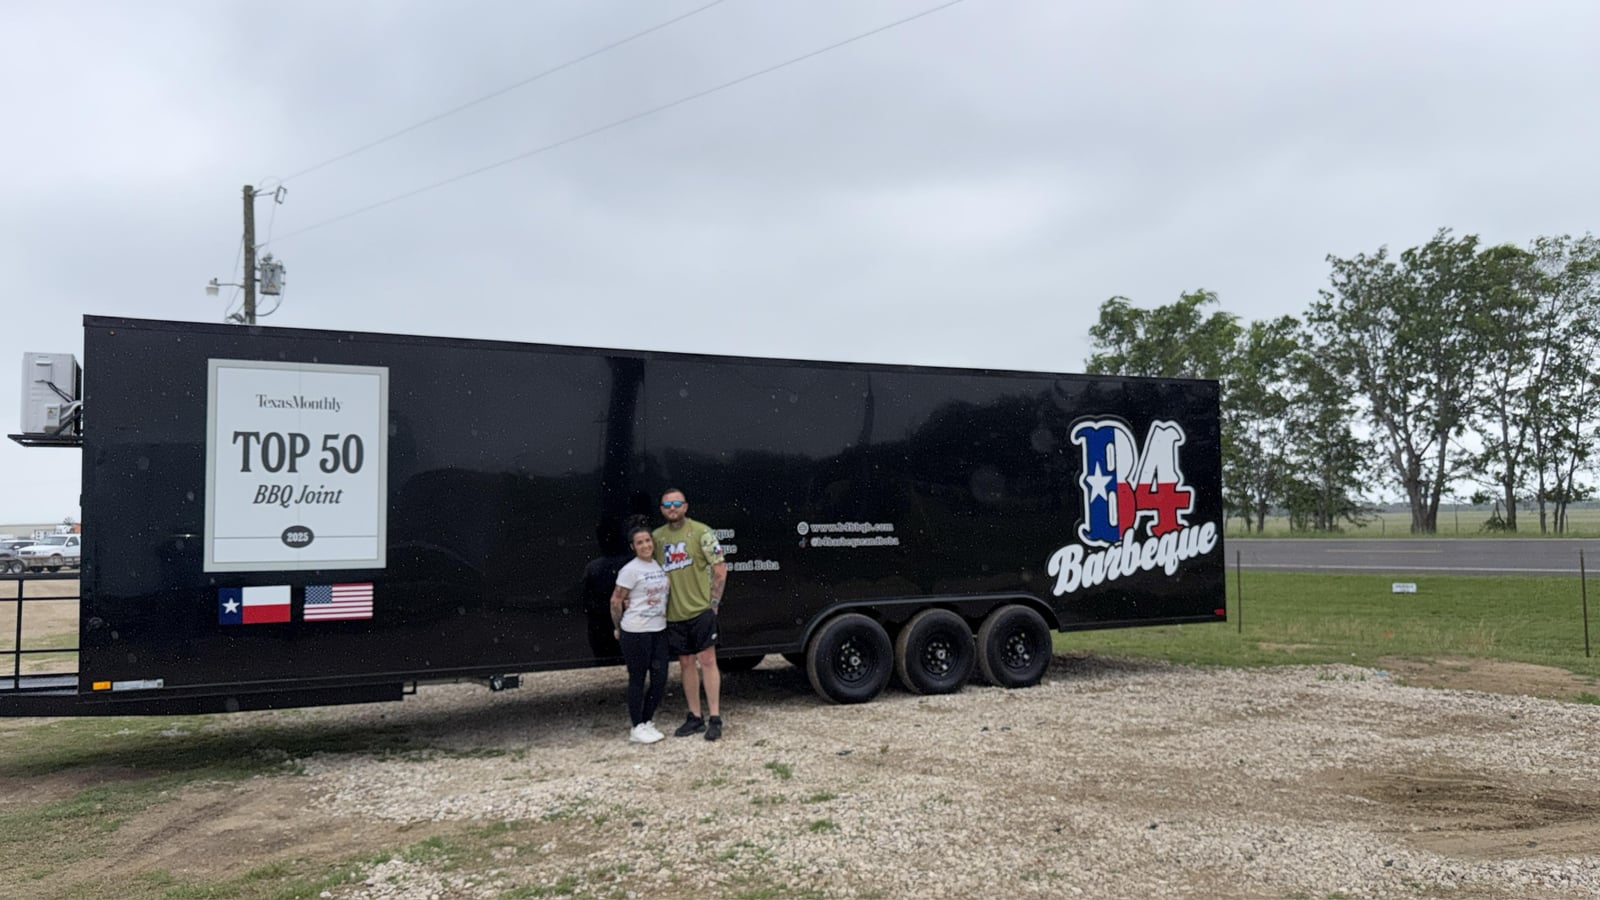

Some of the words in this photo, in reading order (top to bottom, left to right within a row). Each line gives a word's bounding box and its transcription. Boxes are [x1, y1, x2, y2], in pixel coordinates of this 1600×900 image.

[232, 431, 310, 473] TOP
[319, 433, 364, 474] 50
[252, 484, 294, 508] BBQ
[294, 485, 344, 504] Joint
[287, 532, 309, 542] 2025
[734, 560, 753, 571] and
[754, 560, 780, 571] Boba
[1047, 521, 1218, 596] Barbeque
